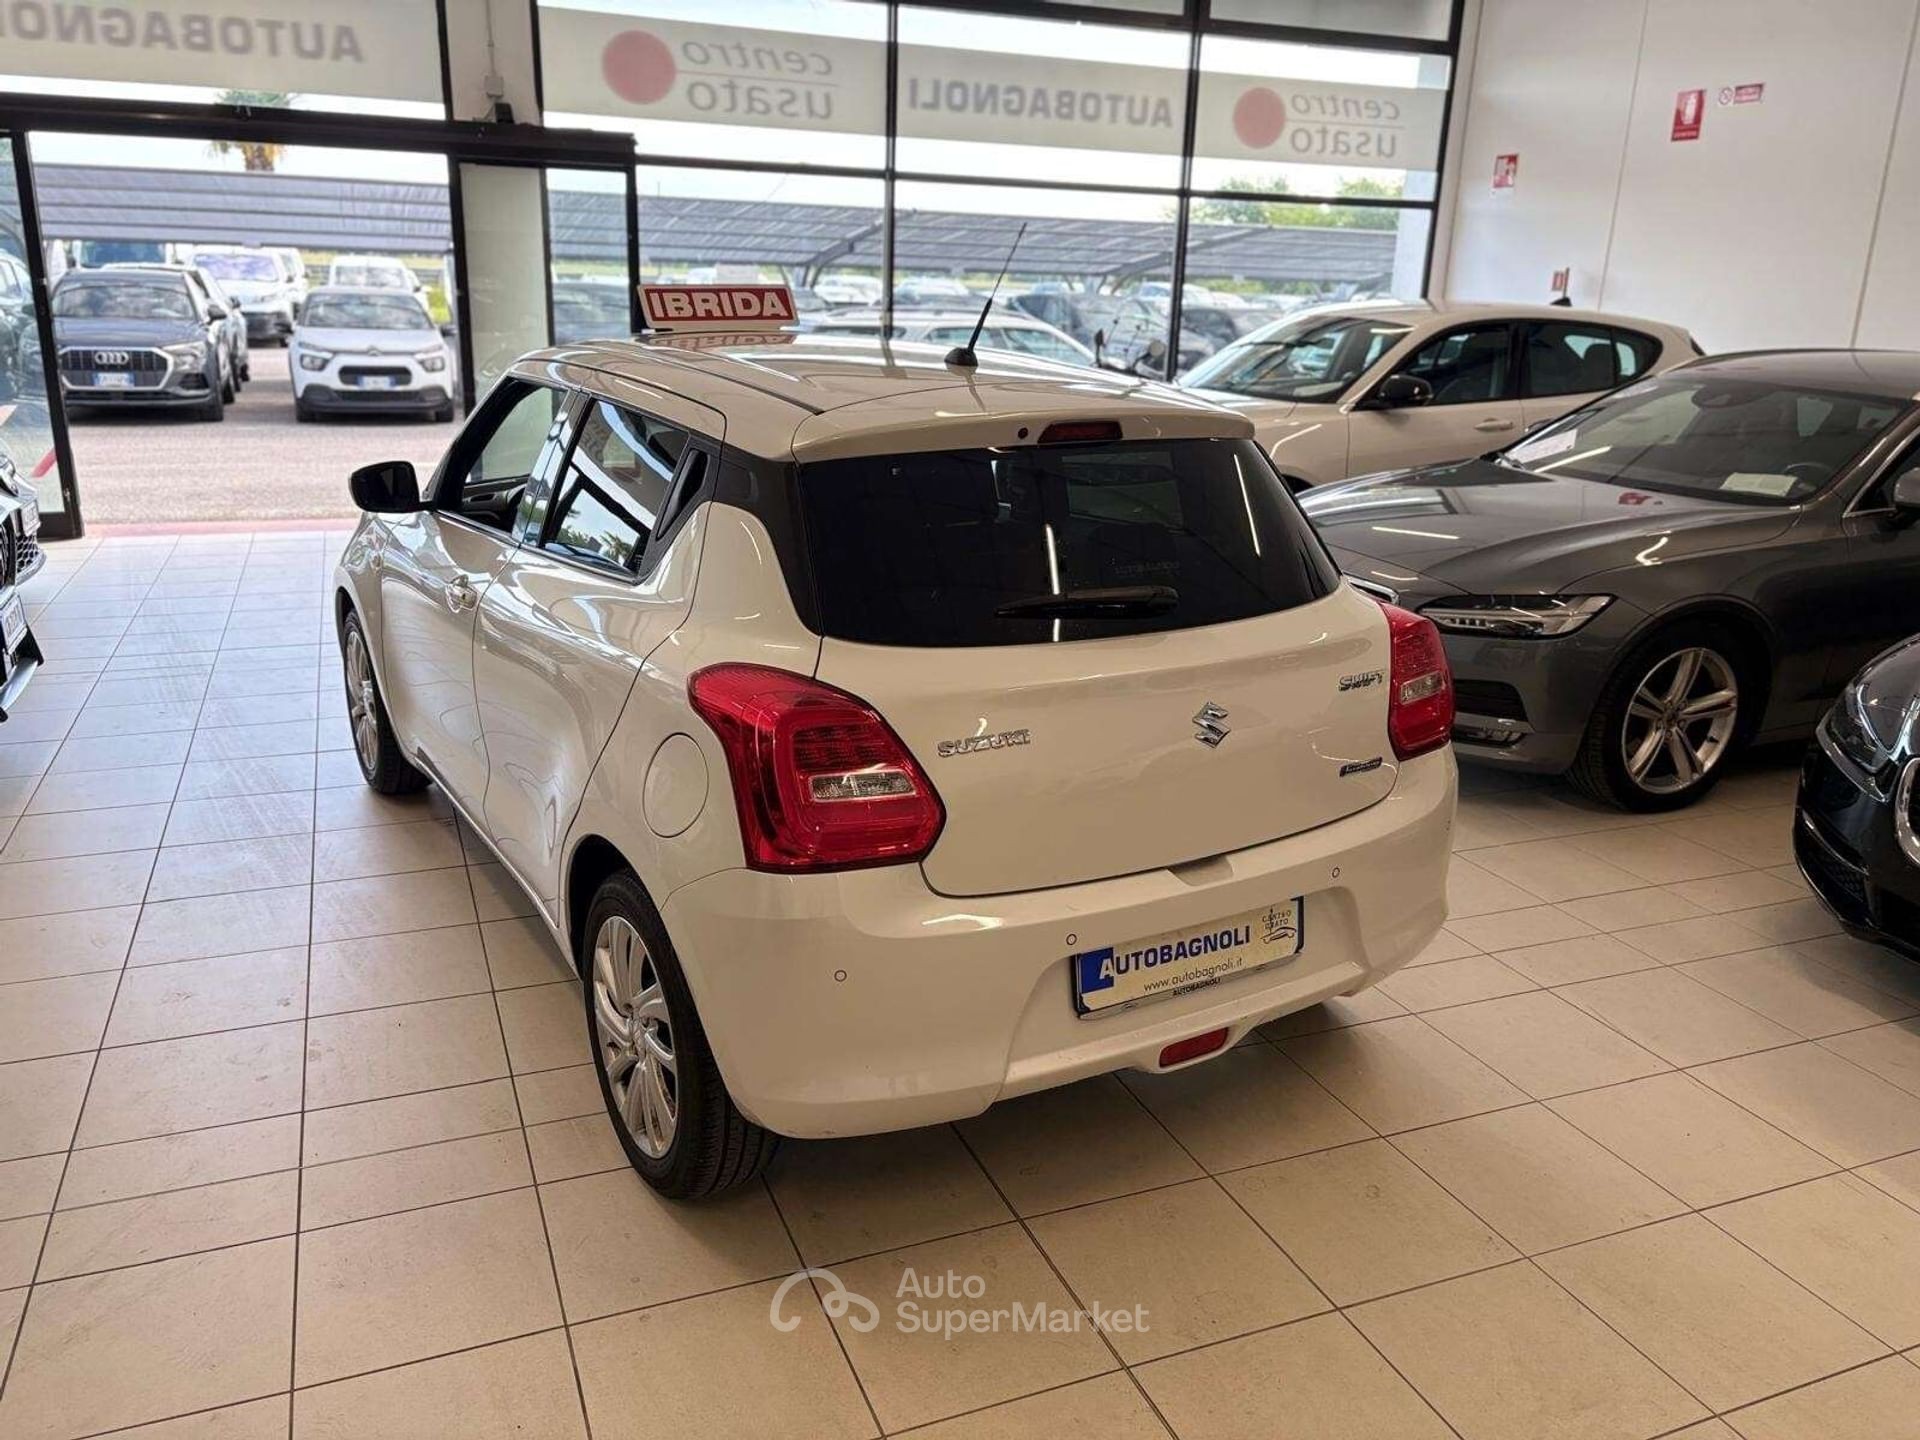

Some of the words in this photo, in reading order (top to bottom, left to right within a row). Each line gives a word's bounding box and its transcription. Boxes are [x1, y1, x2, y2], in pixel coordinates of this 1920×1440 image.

[650, 291, 789, 317] IBRIDA
[1339, 669, 1384, 691] SWIFT
[937, 729, 1031, 758] SUZUKI
[1099, 925, 1250, 980] AUTOBAGNOLI
[1143, 957, 1243, 992] www.autobagnoli.it
[1172, 977, 1221, 996] AUTOBAGNOLI
